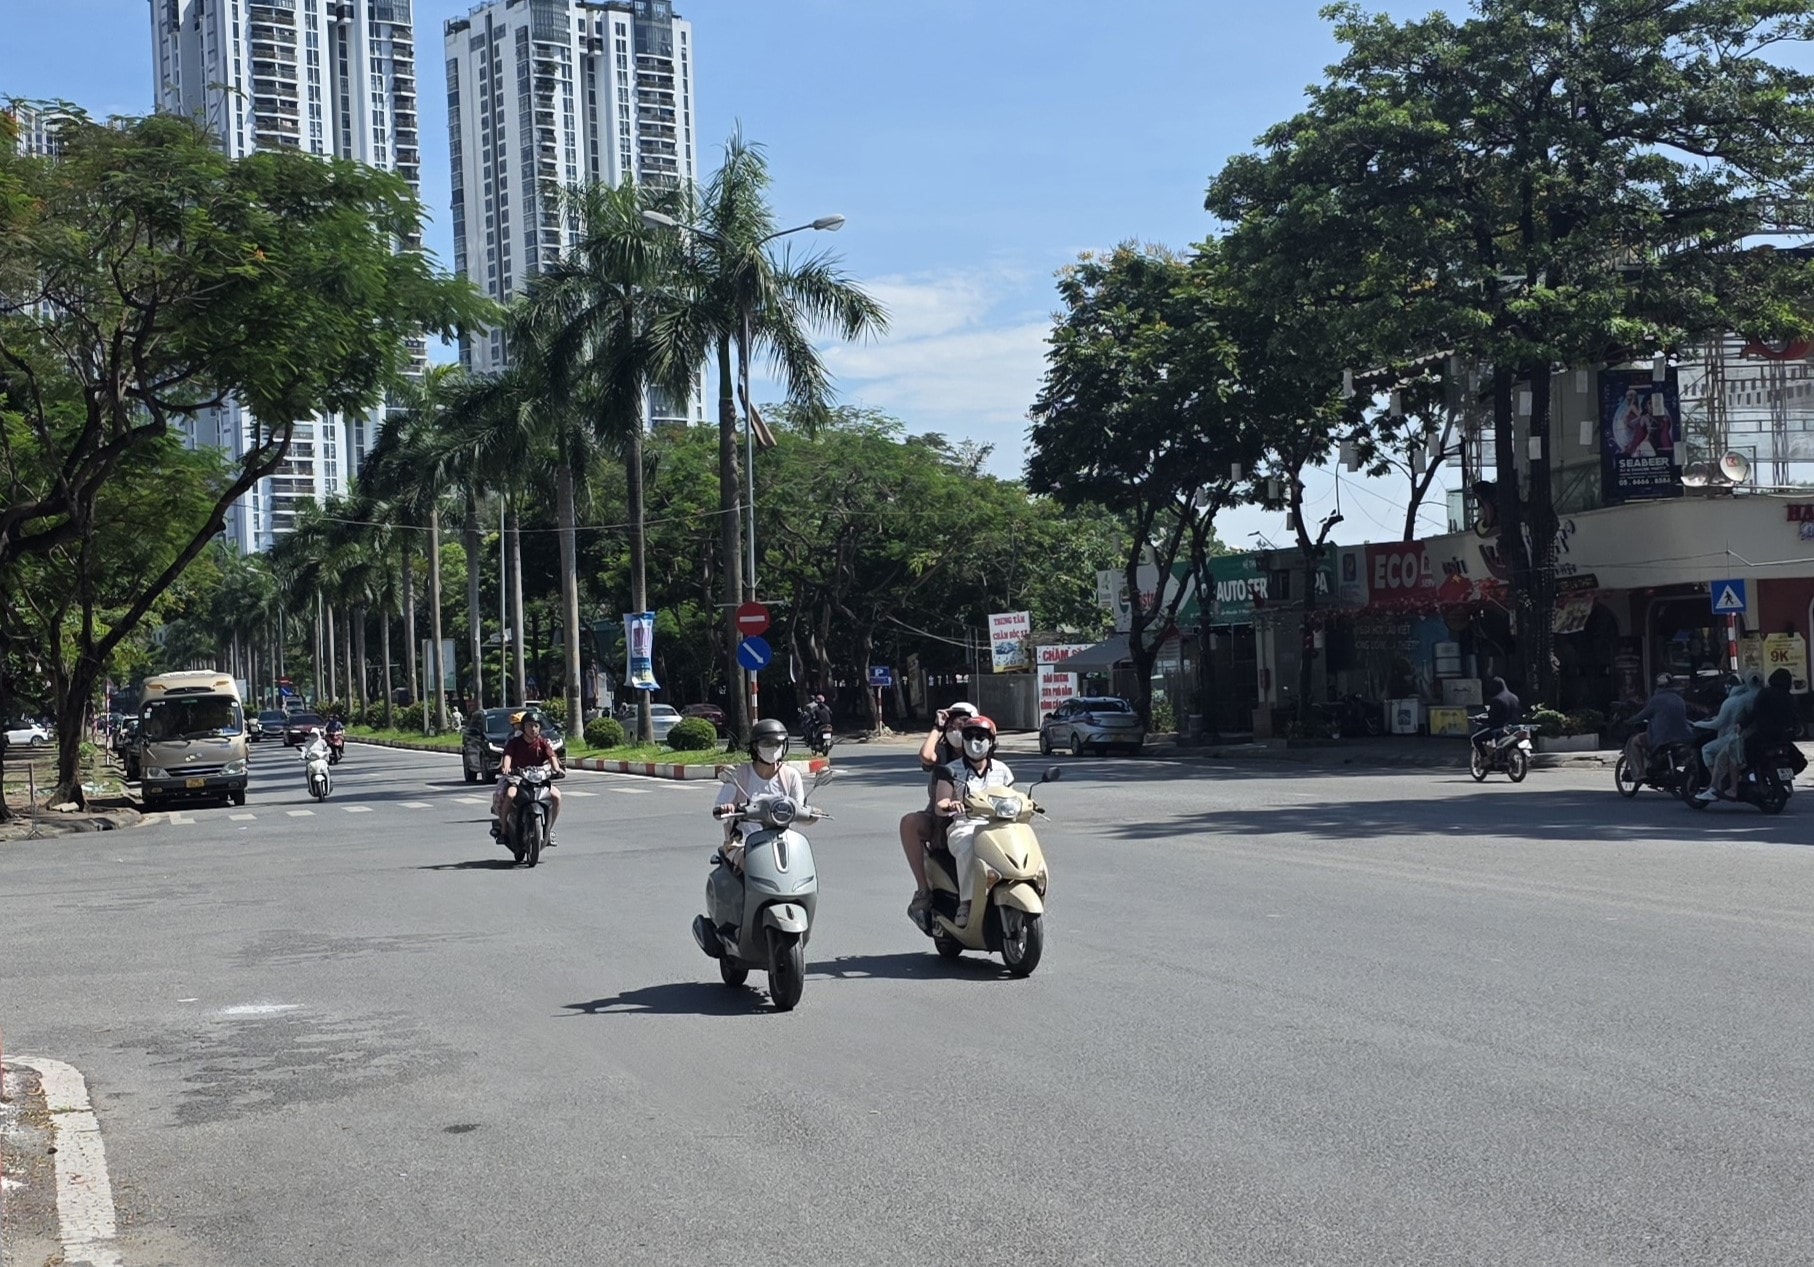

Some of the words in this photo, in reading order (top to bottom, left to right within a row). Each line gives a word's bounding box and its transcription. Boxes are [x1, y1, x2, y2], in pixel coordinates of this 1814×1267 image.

[1618, 456, 1670, 468] SEABEER
[1374, 552, 1419, 590] ECO
[1216, 579, 1246, 602] AUTO
[1770, 650, 1789, 662] 9K
[874, 668, 884, 677] P
